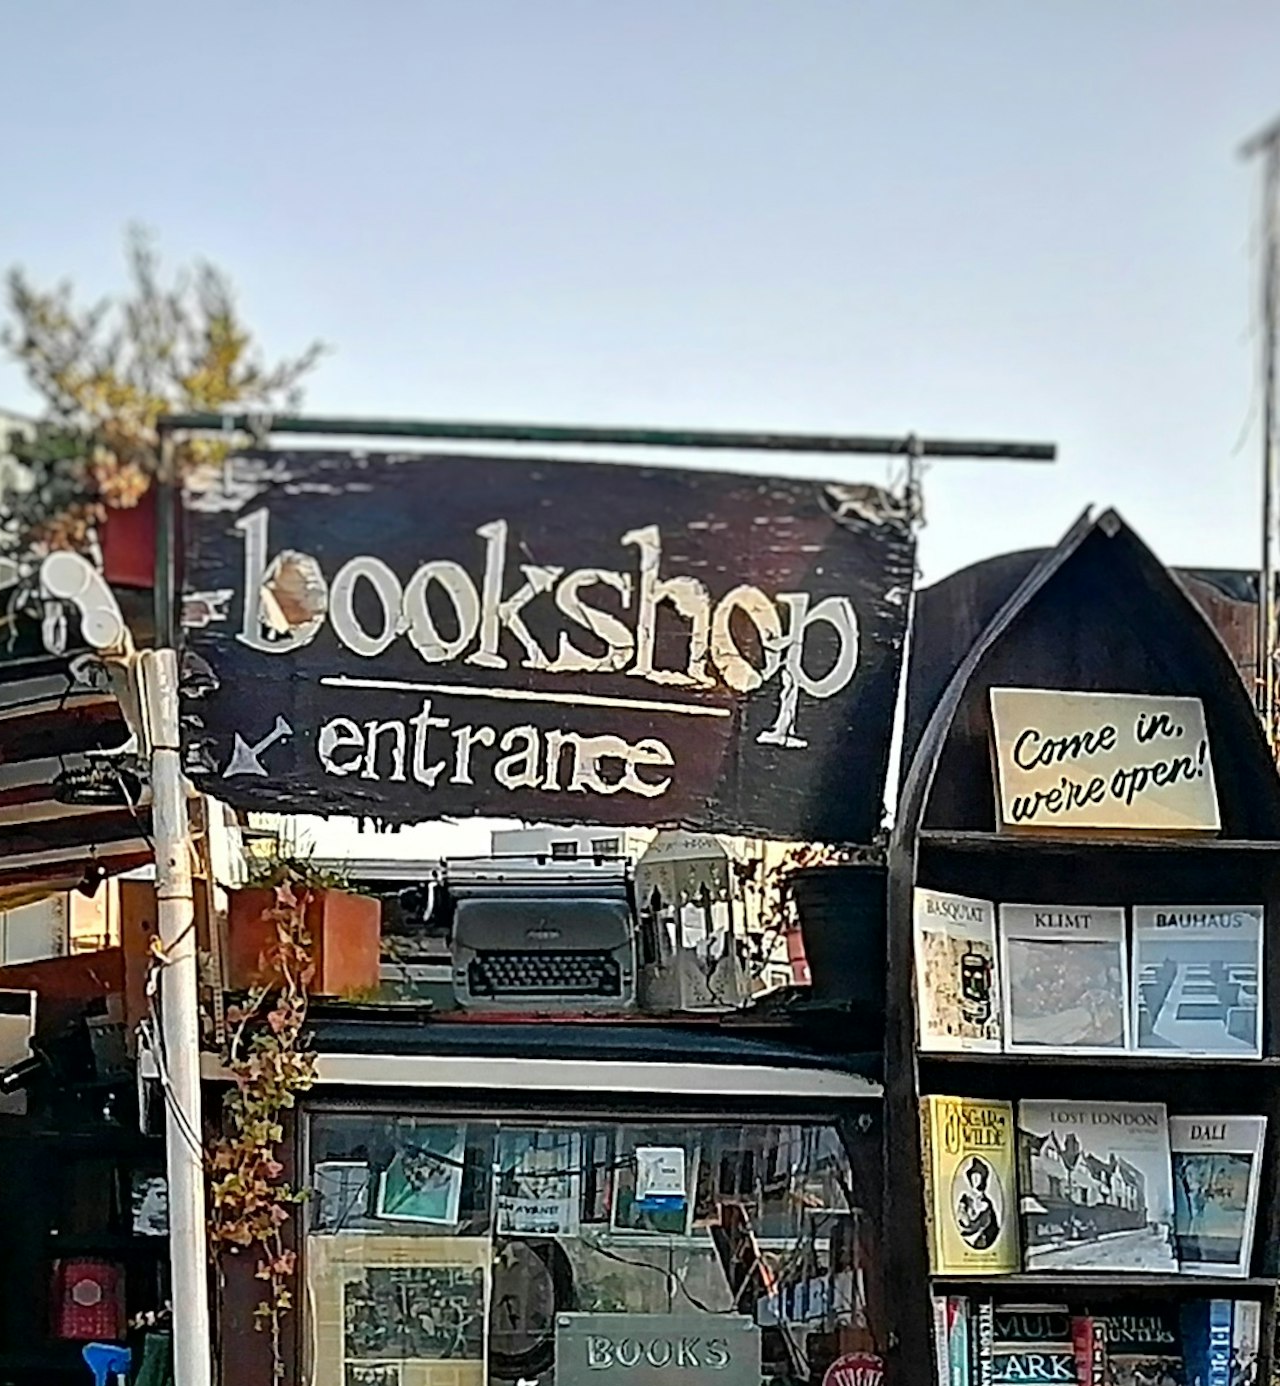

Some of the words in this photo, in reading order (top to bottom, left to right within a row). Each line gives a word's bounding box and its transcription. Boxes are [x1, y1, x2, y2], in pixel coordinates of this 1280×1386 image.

[234, 508, 860, 748] bookshop
[318, 699, 675, 797] entrance
[1014, 726, 1116, 770] Come
[1136, 713, 1184, 743] in,
[1012, 777, 1105, 821] we're
[1111, 740, 1207, 806] open!
[926, 899, 984, 922] BASQUIAT
[1034, 913, 1092, 929] KLIMT
[1156, 913, 1243, 929] BAUHAUS
[1050, 1111, 1085, 1124] LOST
[1092, 1112, 1159, 1127] LONDON
[961, 1127, 1007, 1147] WILDE
[979, 1303, 992, 1356] NELSON
[586, 1335, 732, 1370] BOOKS
